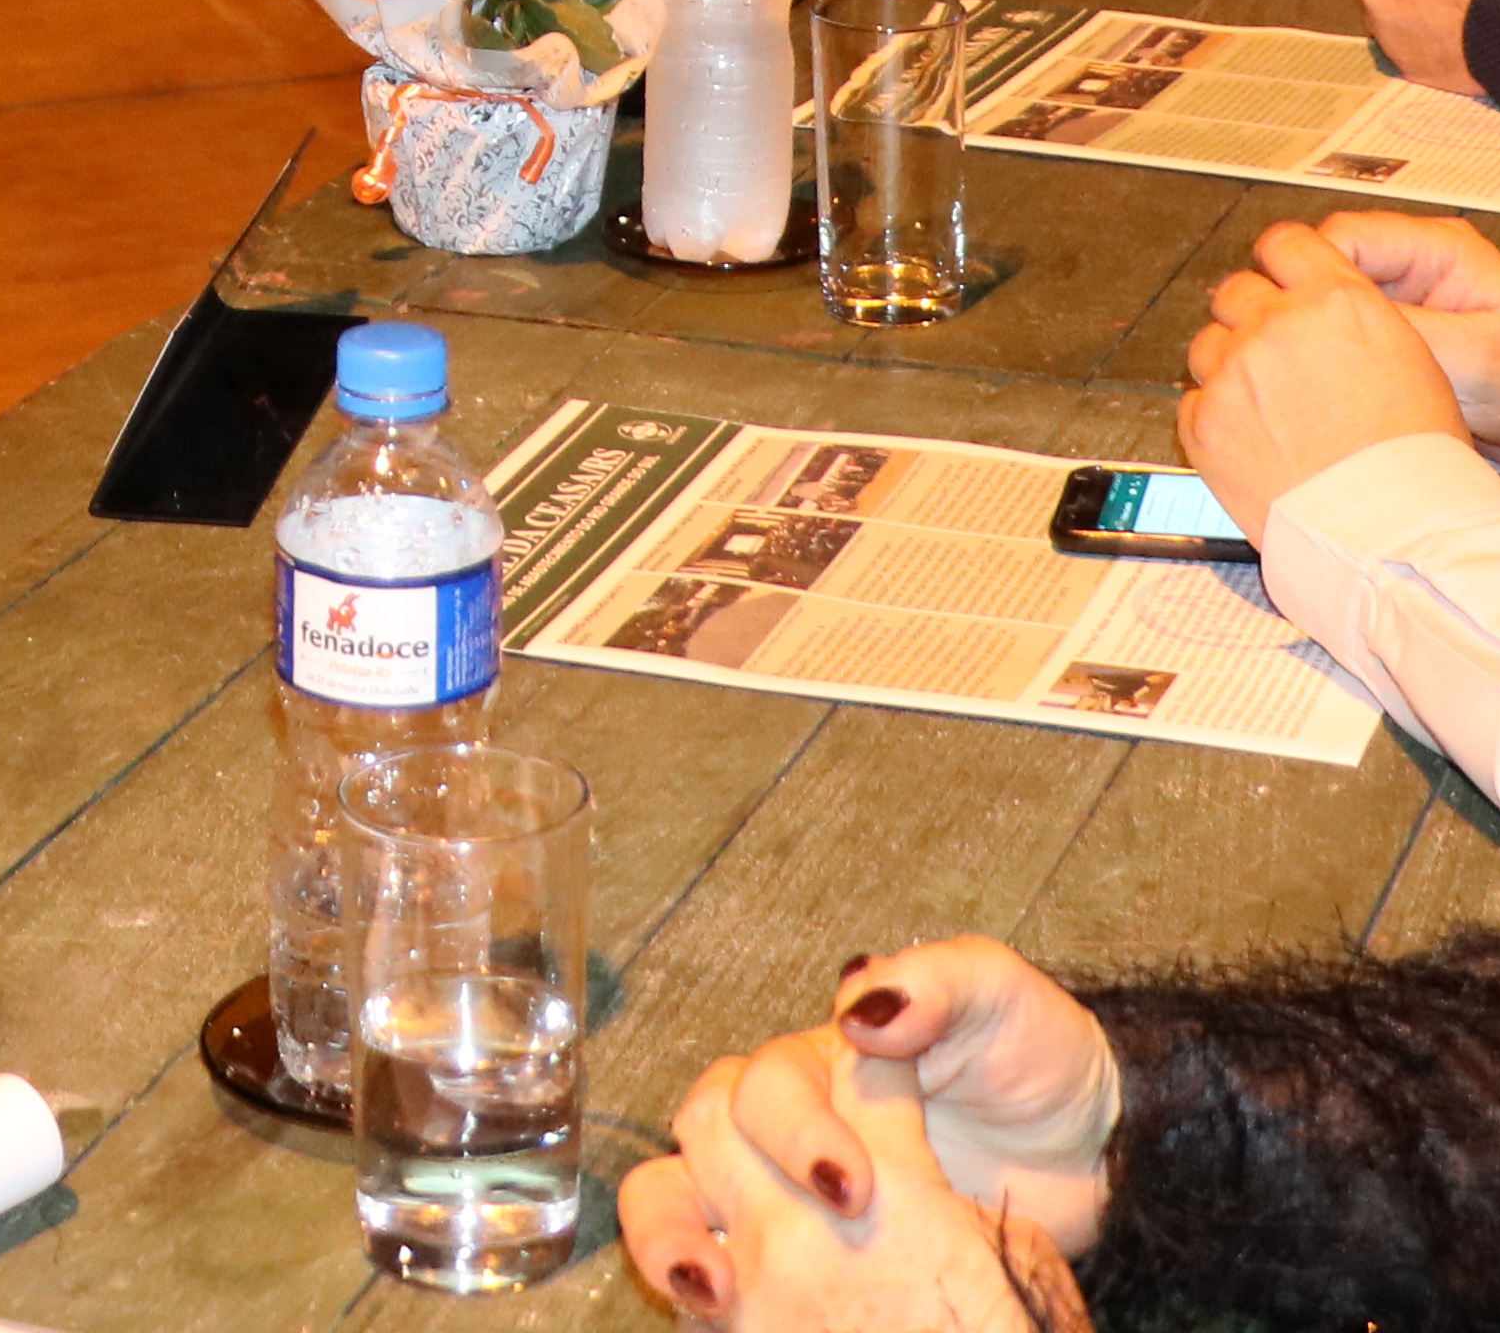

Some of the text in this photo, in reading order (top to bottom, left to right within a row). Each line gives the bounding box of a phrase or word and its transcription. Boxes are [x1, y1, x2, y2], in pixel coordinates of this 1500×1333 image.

[502, 529, 548, 554] DA
[525, 448, 627, 527] CEASA/RS
[301, 620, 430, 659] fenadoce
